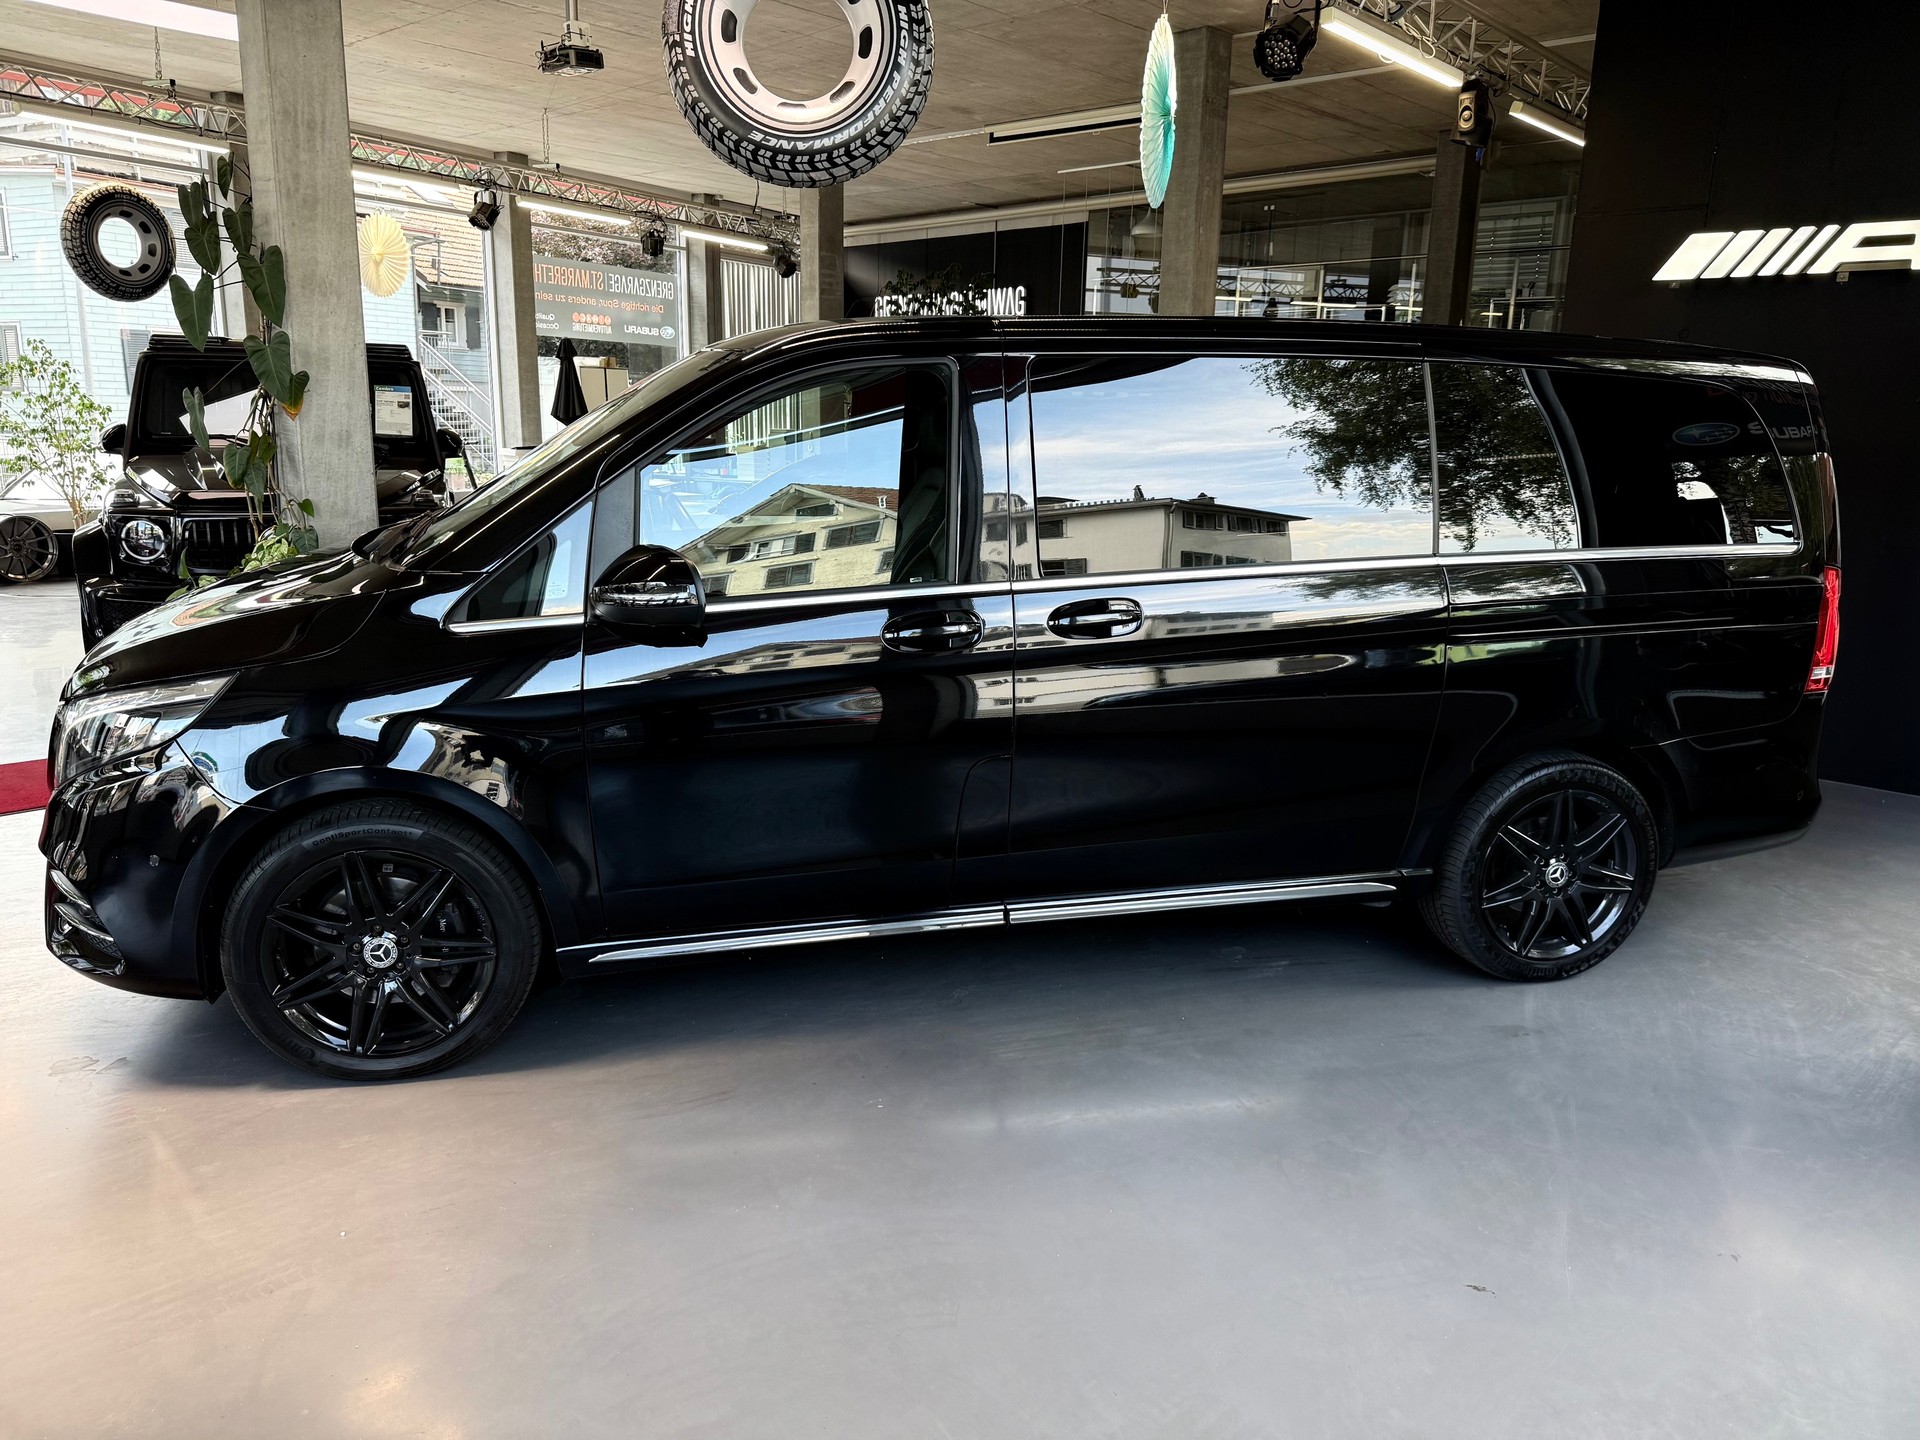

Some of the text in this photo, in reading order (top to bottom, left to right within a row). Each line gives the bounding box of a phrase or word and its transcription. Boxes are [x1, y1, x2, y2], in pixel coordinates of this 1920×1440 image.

[683, 0, 696, 58] HIGH
[747, 4, 910, 152] HIGH PERFORMANCE
[114, 193, 138, 203] HIGH
[118, 285, 143, 294] HIGH
